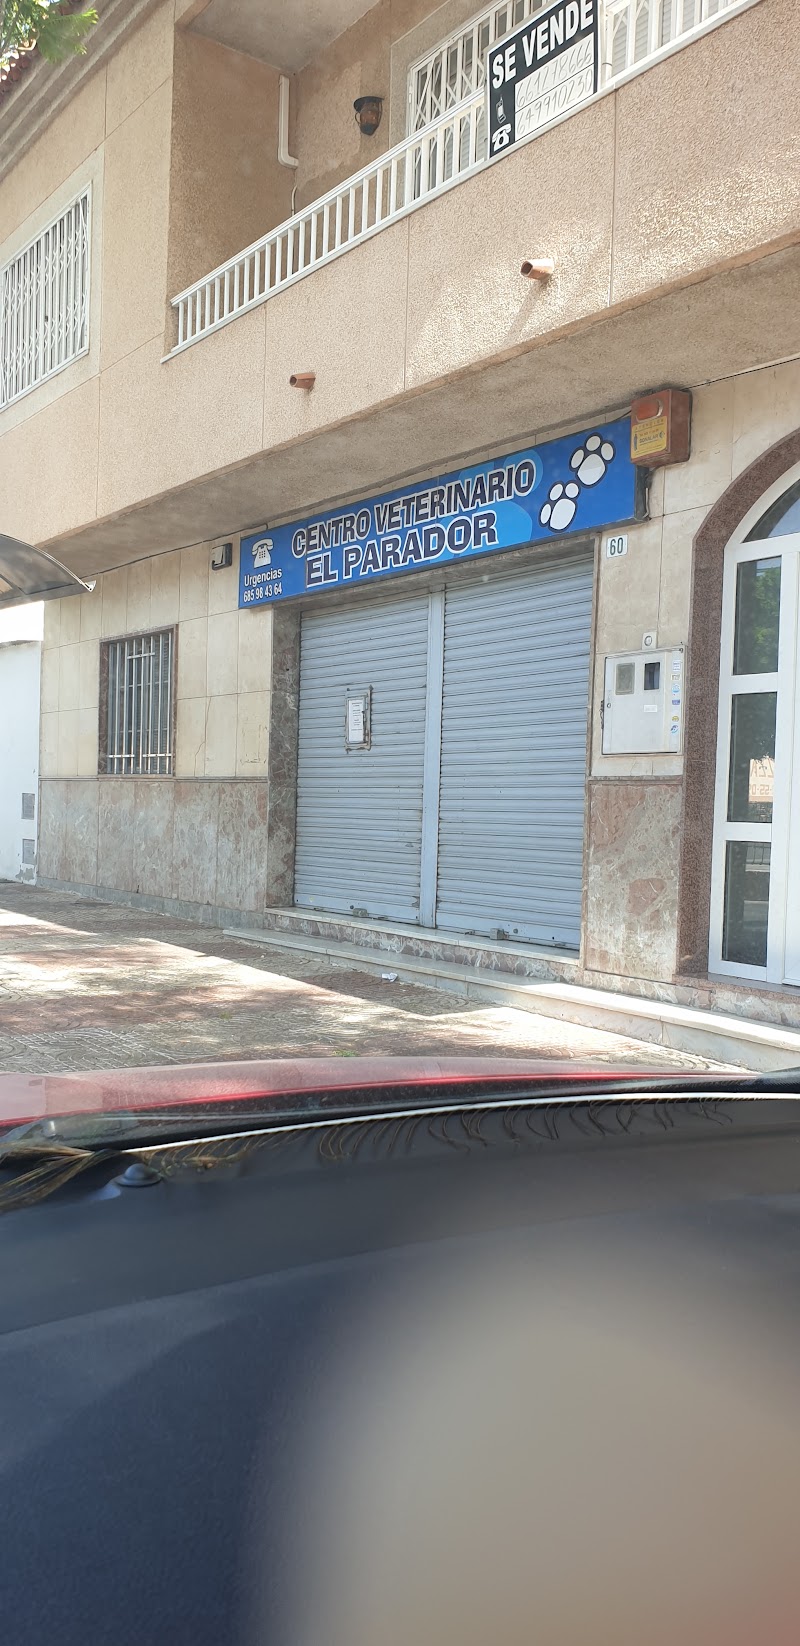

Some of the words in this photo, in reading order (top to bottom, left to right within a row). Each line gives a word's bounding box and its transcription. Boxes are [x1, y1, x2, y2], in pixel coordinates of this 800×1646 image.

[492, 43, 517, 89] SE
[522, 0, 594, 68] VENDE
[292, 508, 372, 558] CENTRO
[374, 459, 536, 535] VETERINARIO
[306, 551, 338, 588] EL
[343, 510, 499, 579] PARADOR
[610, 537, 624, 556] 60
[244, 568, 282, 587] Urgencias
[255, 587, 263, 599] 98
[264, 584, 272, 597] 43
[274, 582, 282, 595] 64
